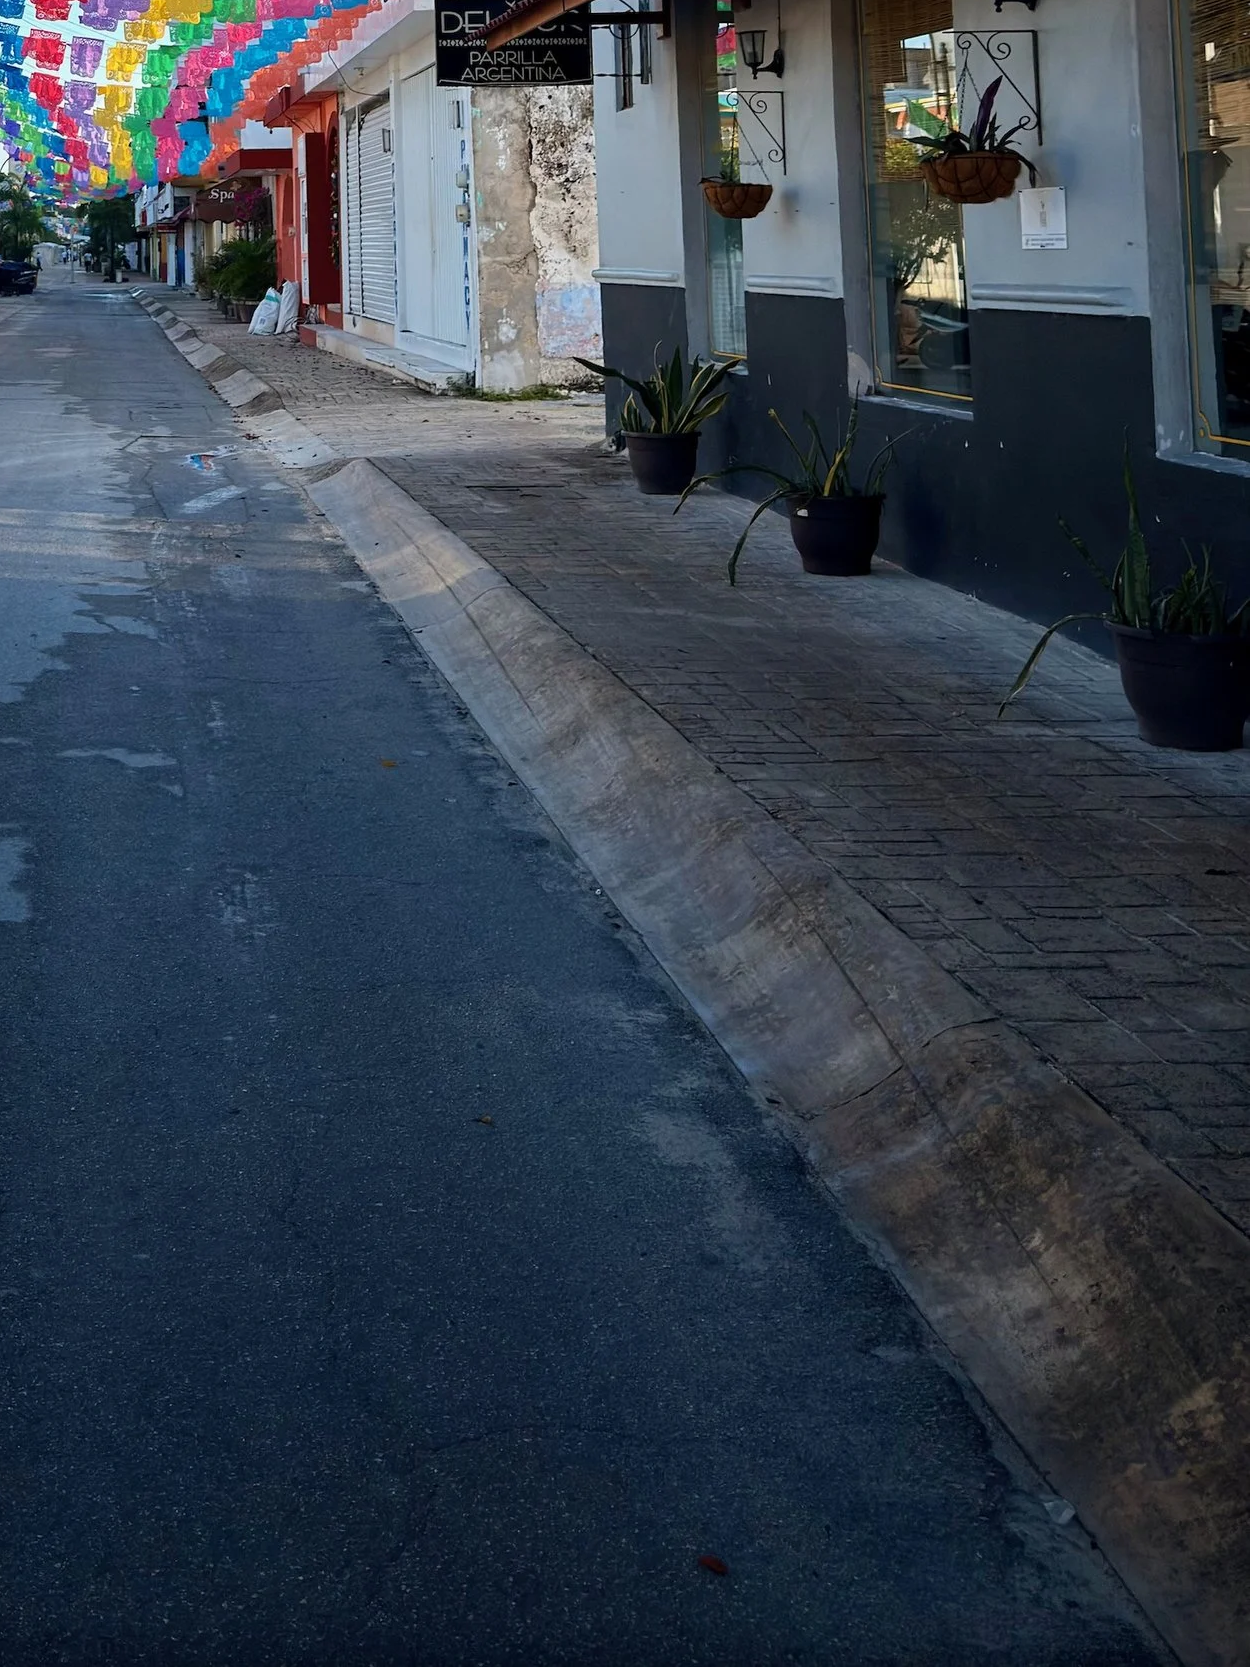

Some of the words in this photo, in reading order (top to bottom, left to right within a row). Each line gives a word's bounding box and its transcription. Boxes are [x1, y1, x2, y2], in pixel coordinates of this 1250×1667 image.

[469, 50, 558, 66] PARRILLA
[460, 66, 567, 82] ARGENTINA
[208, 188, 235, 203] Spa
